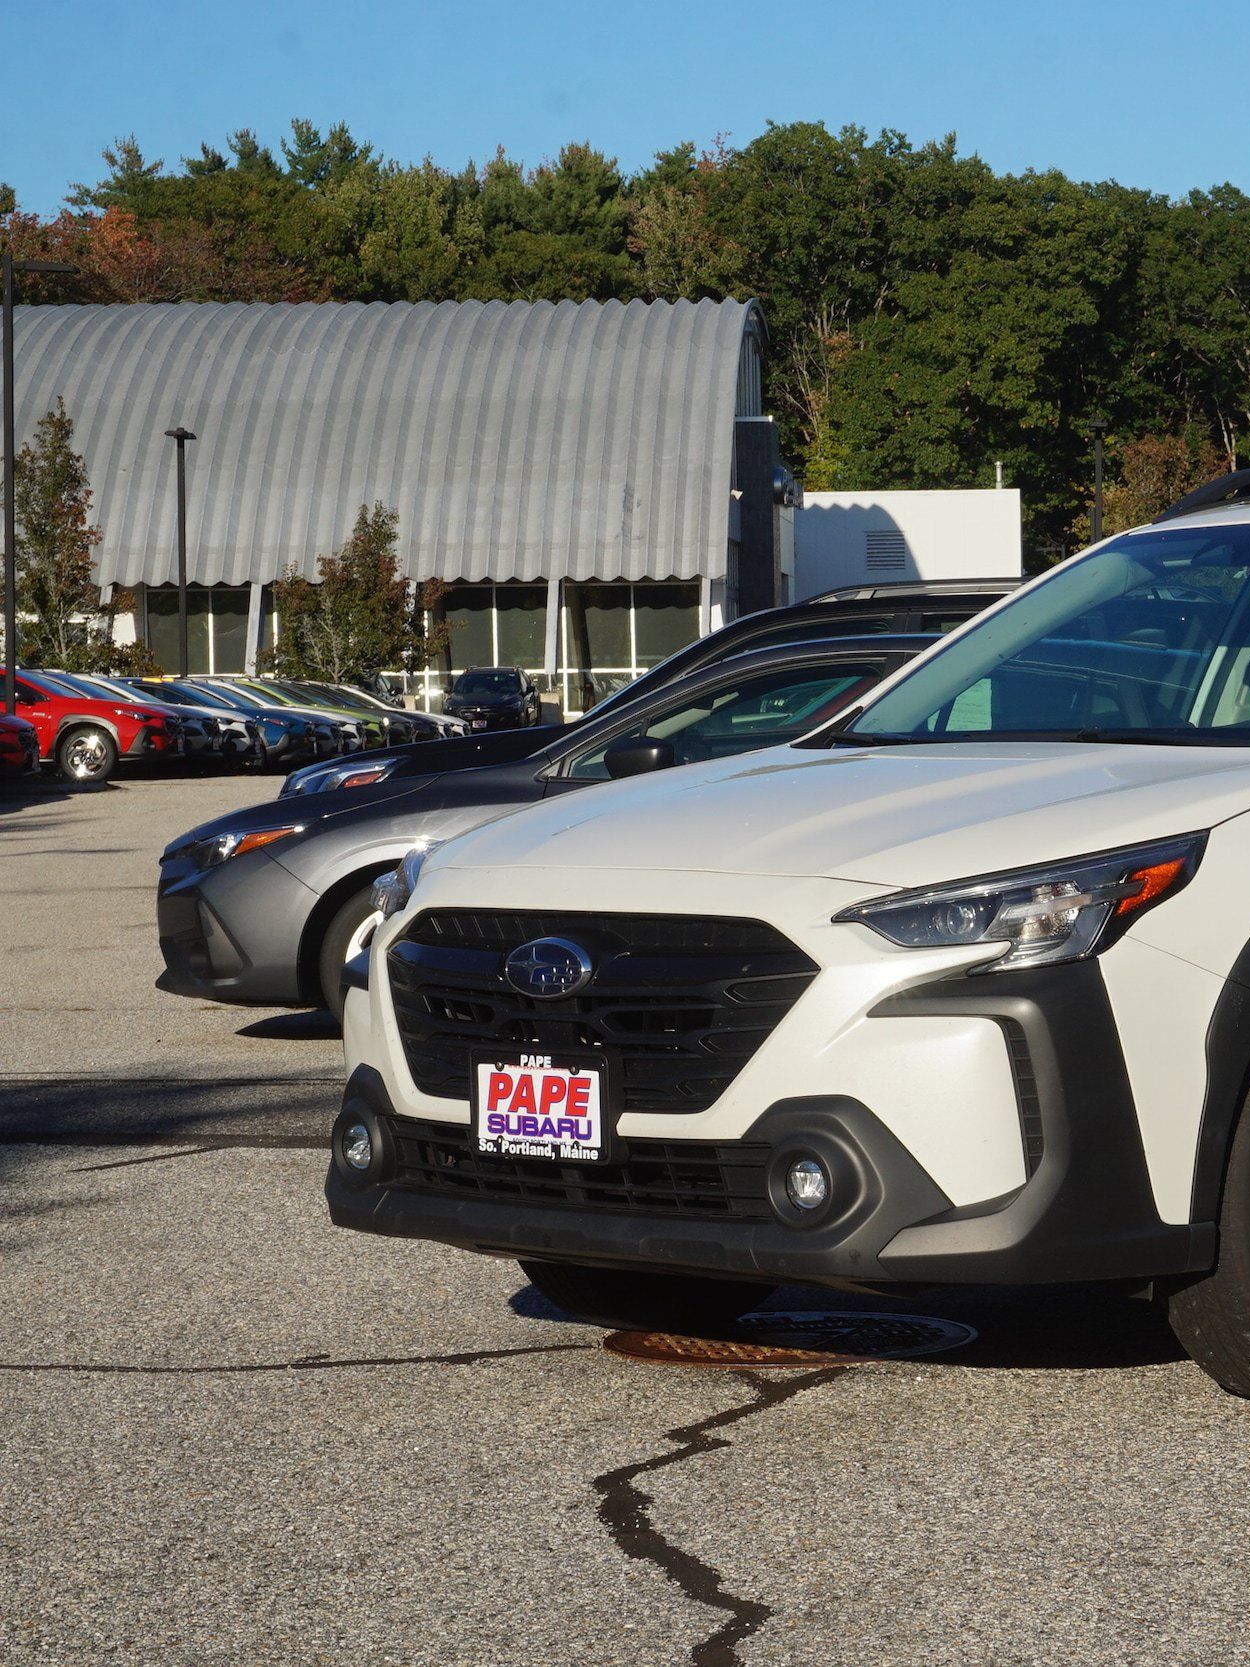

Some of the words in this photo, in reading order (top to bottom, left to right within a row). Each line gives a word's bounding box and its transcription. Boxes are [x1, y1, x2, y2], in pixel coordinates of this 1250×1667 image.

[520, 1054, 552, 1068] PAPE
[487, 1072, 591, 1117] PAPE
[487, 1113, 592, 1140] SUBARU
[478, 1138, 497, 1152] So.
[501, 1141, 556, 1160] Portland,
[560, 1144, 598, 1160] Maine
